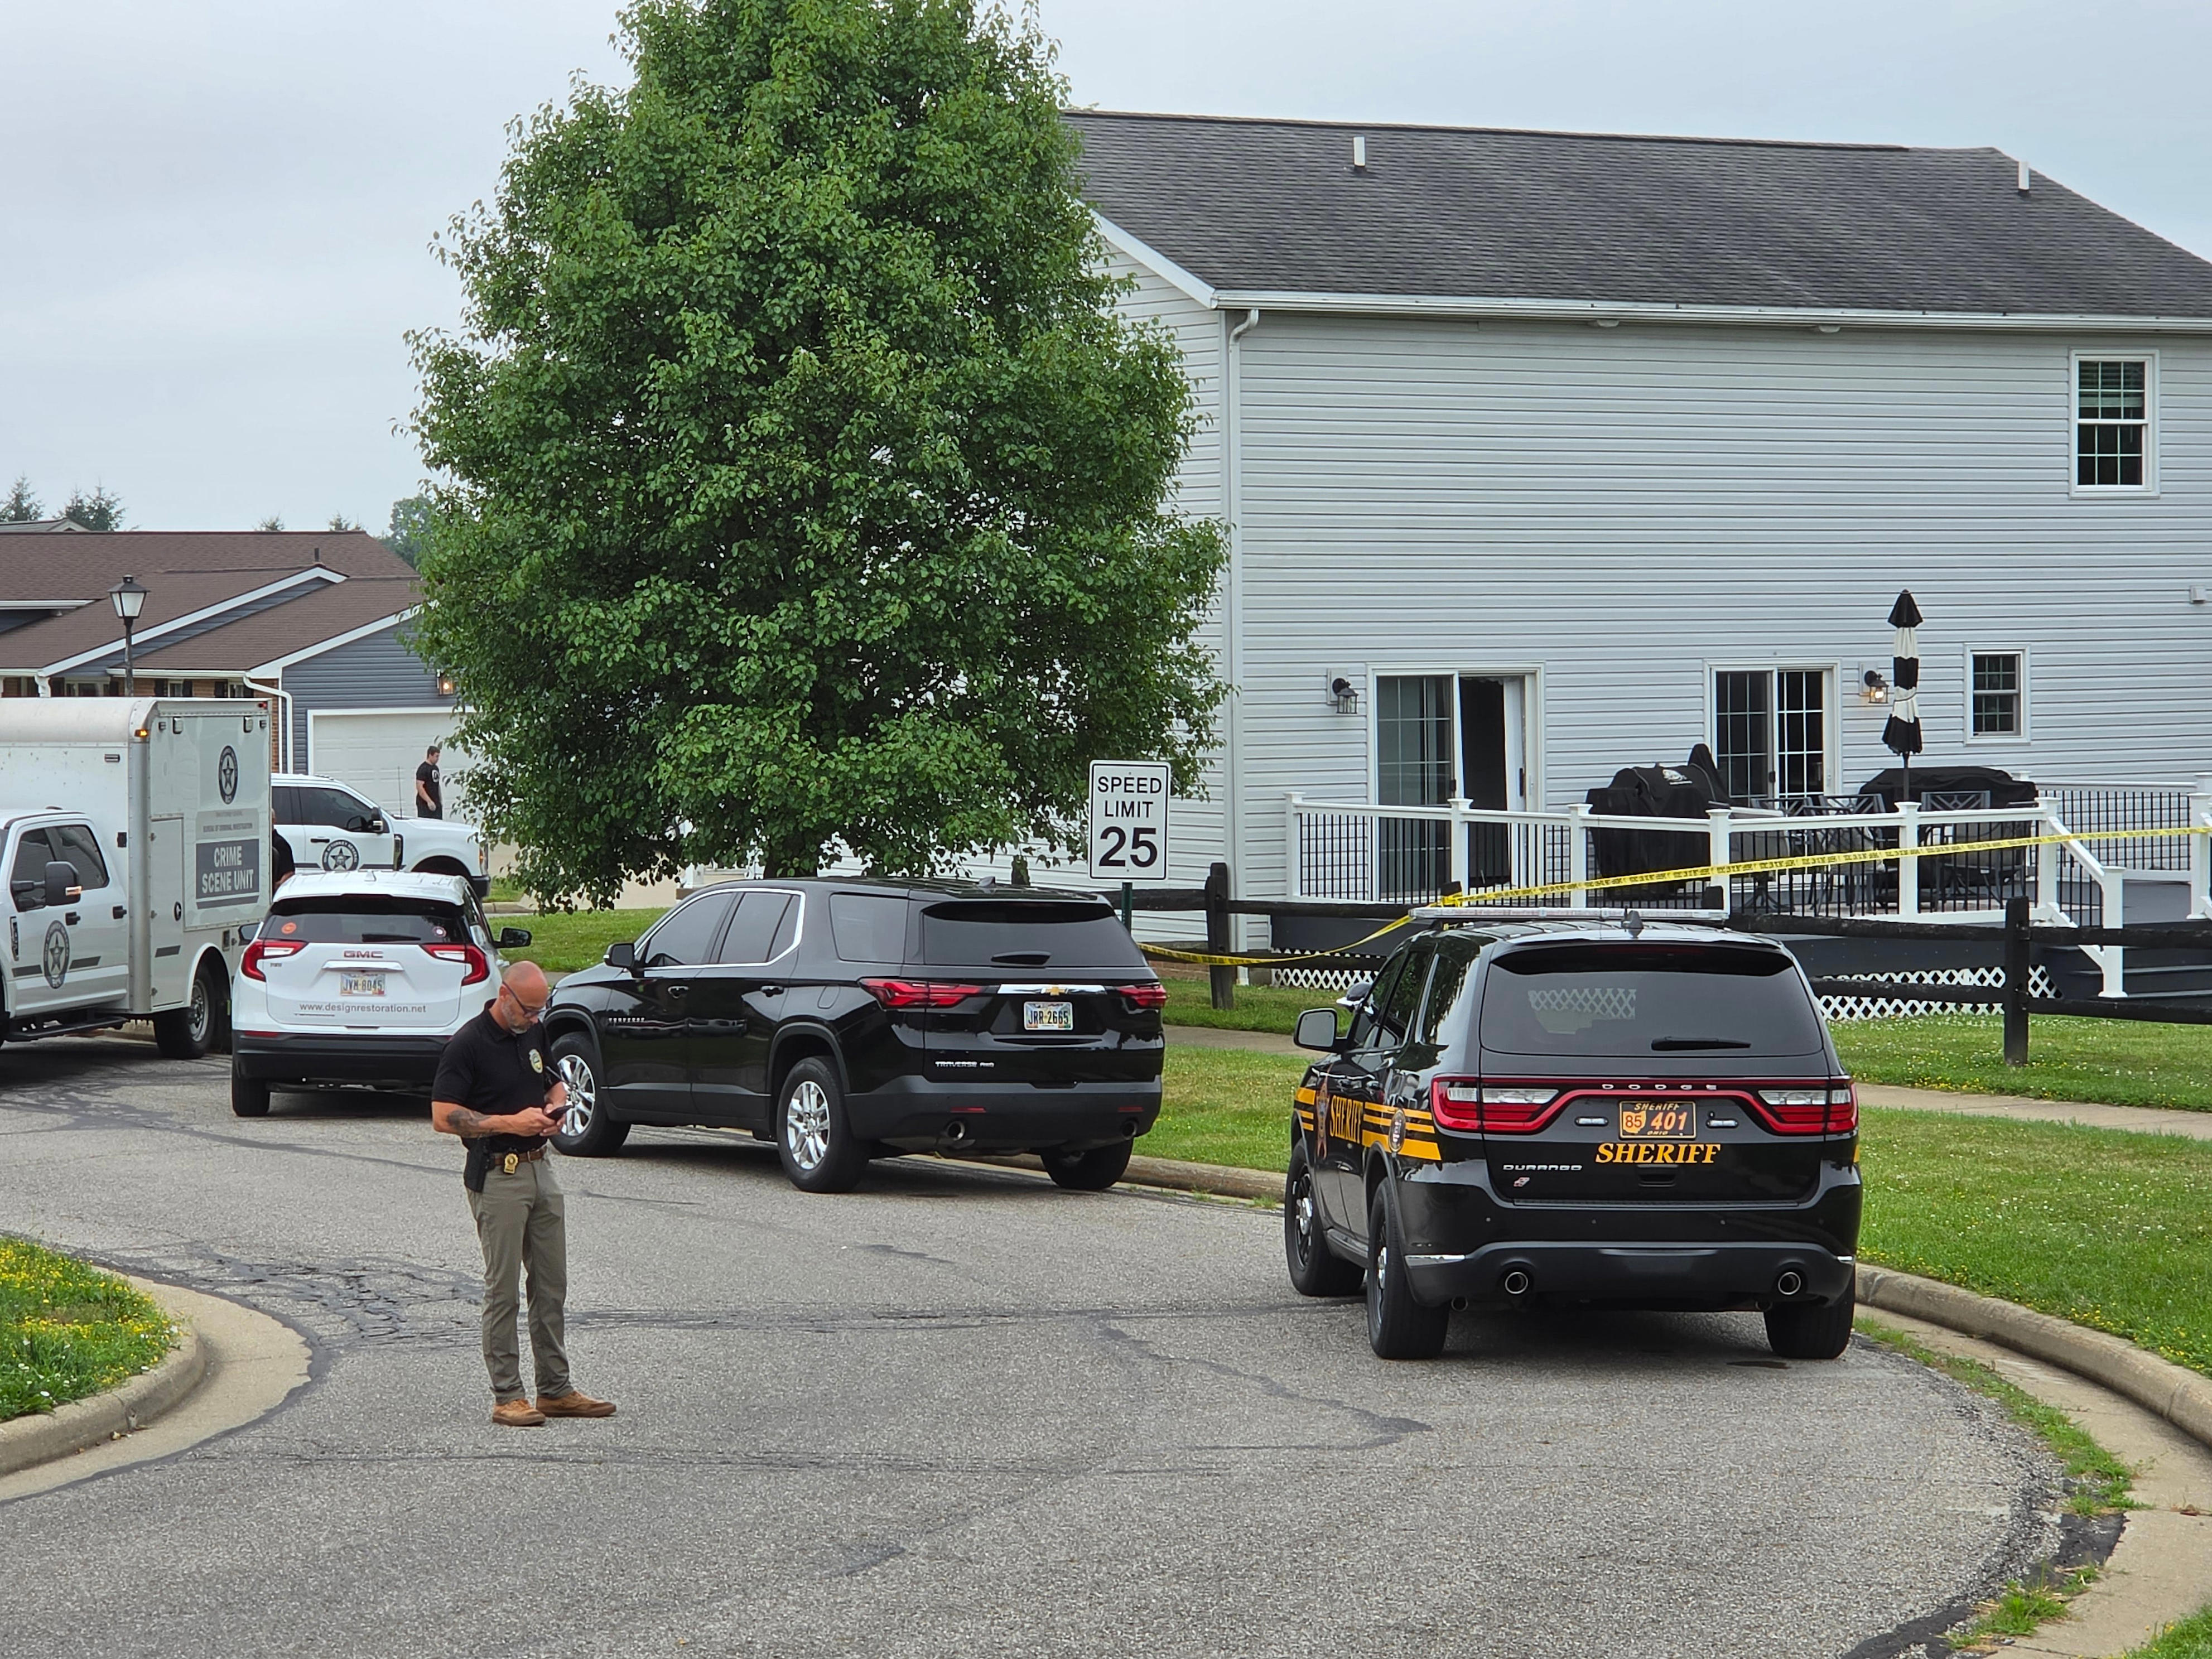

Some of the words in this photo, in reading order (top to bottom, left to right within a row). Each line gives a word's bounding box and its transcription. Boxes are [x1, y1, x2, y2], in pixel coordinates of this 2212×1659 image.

[1097, 776, 1162, 794] SPEED
[1105, 800, 1154, 818] LIMIT
[214, 846, 242, 867] CRIME
[1098, 826, 1158, 867] 25
[201, 871, 232, 893] SCENE
[234, 869, 253, 890] UNIT
[300, 1004, 426, 1013] www.designrestoration.net
[1028, 1010, 1044, 1024] JRR
[1047, 1011, 1069, 1024] 2665
[1329, 1094, 1363, 1144] SHERIFF
[1625, 1115, 1642, 1128] 85
[1651, 1112, 1688, 1131] 401
[1595, 1143, 1721, 1164] SHERIFF
